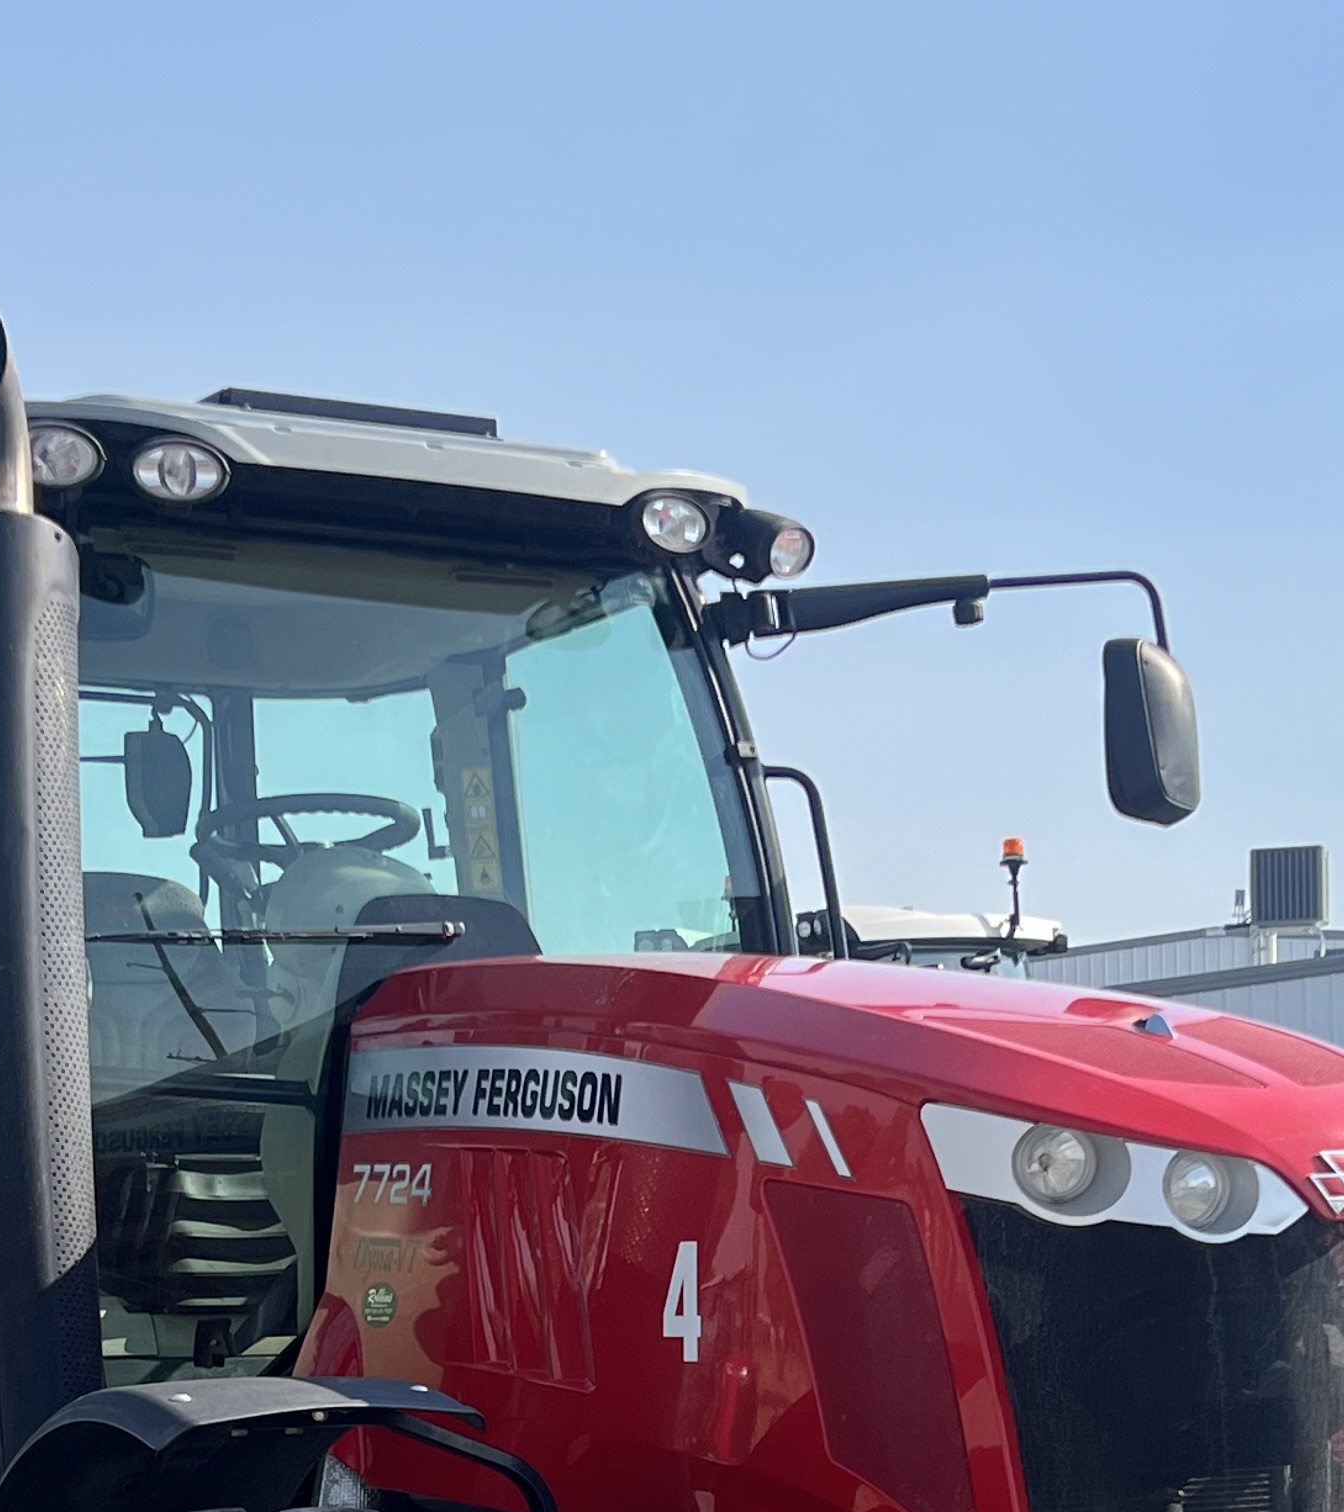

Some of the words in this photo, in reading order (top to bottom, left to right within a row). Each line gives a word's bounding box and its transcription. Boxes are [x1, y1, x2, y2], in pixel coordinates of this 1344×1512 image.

[365, 1068, 468, 1119] MASSEY
[471, 1068, 623, 1126] FERGUSON
[353, 1163, 433, 1207] 7724
[662, 1240, 702, 1362] 4
